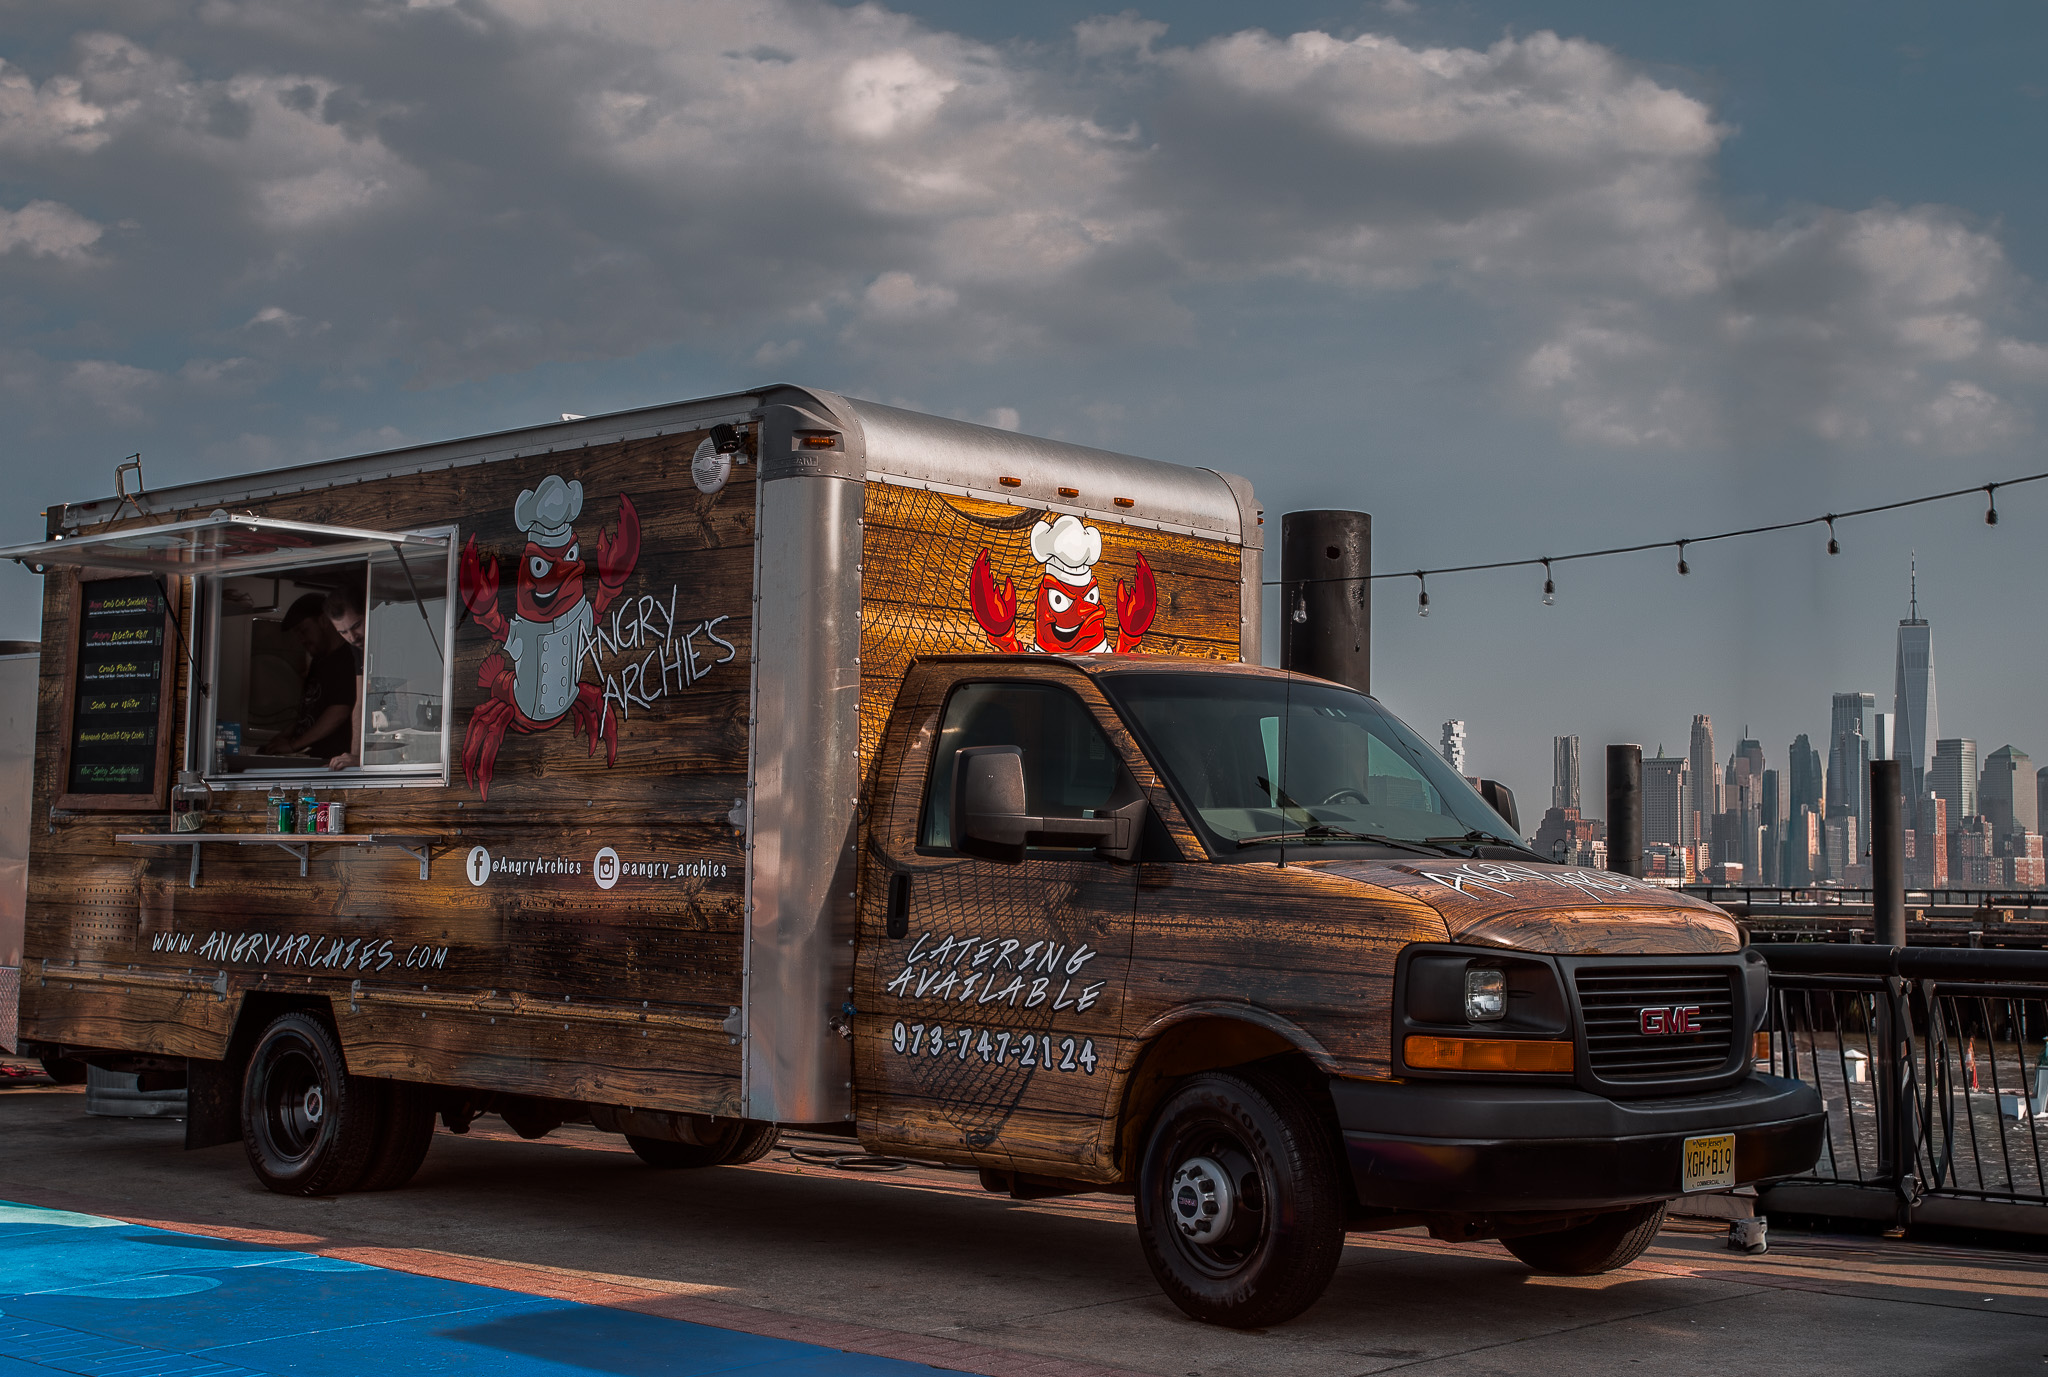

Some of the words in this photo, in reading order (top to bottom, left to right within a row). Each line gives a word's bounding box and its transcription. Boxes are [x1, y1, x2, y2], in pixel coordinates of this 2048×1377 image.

[575, 584, 677, 684] ANGRY
[599, 615, 736, 738] ARCHIE'S
[492, 856, 582, 876] @AngryArchies
[622, 858, 727, 880] @angry_archies
[152, 931, 448, 971] WWW.ANGRYARCHIES.COM
[907, 933, 1098, 975] CATERING
[888, 966, 1106, 1012] AVAILABLE
[1640, 1006, 1701, 1035] GMC
[894, 1022, 1097, 1073] 973-747-2124
[1695, 1140, 1707, 1149] New
[1707, 1138, 1722, 1149] Jersey
